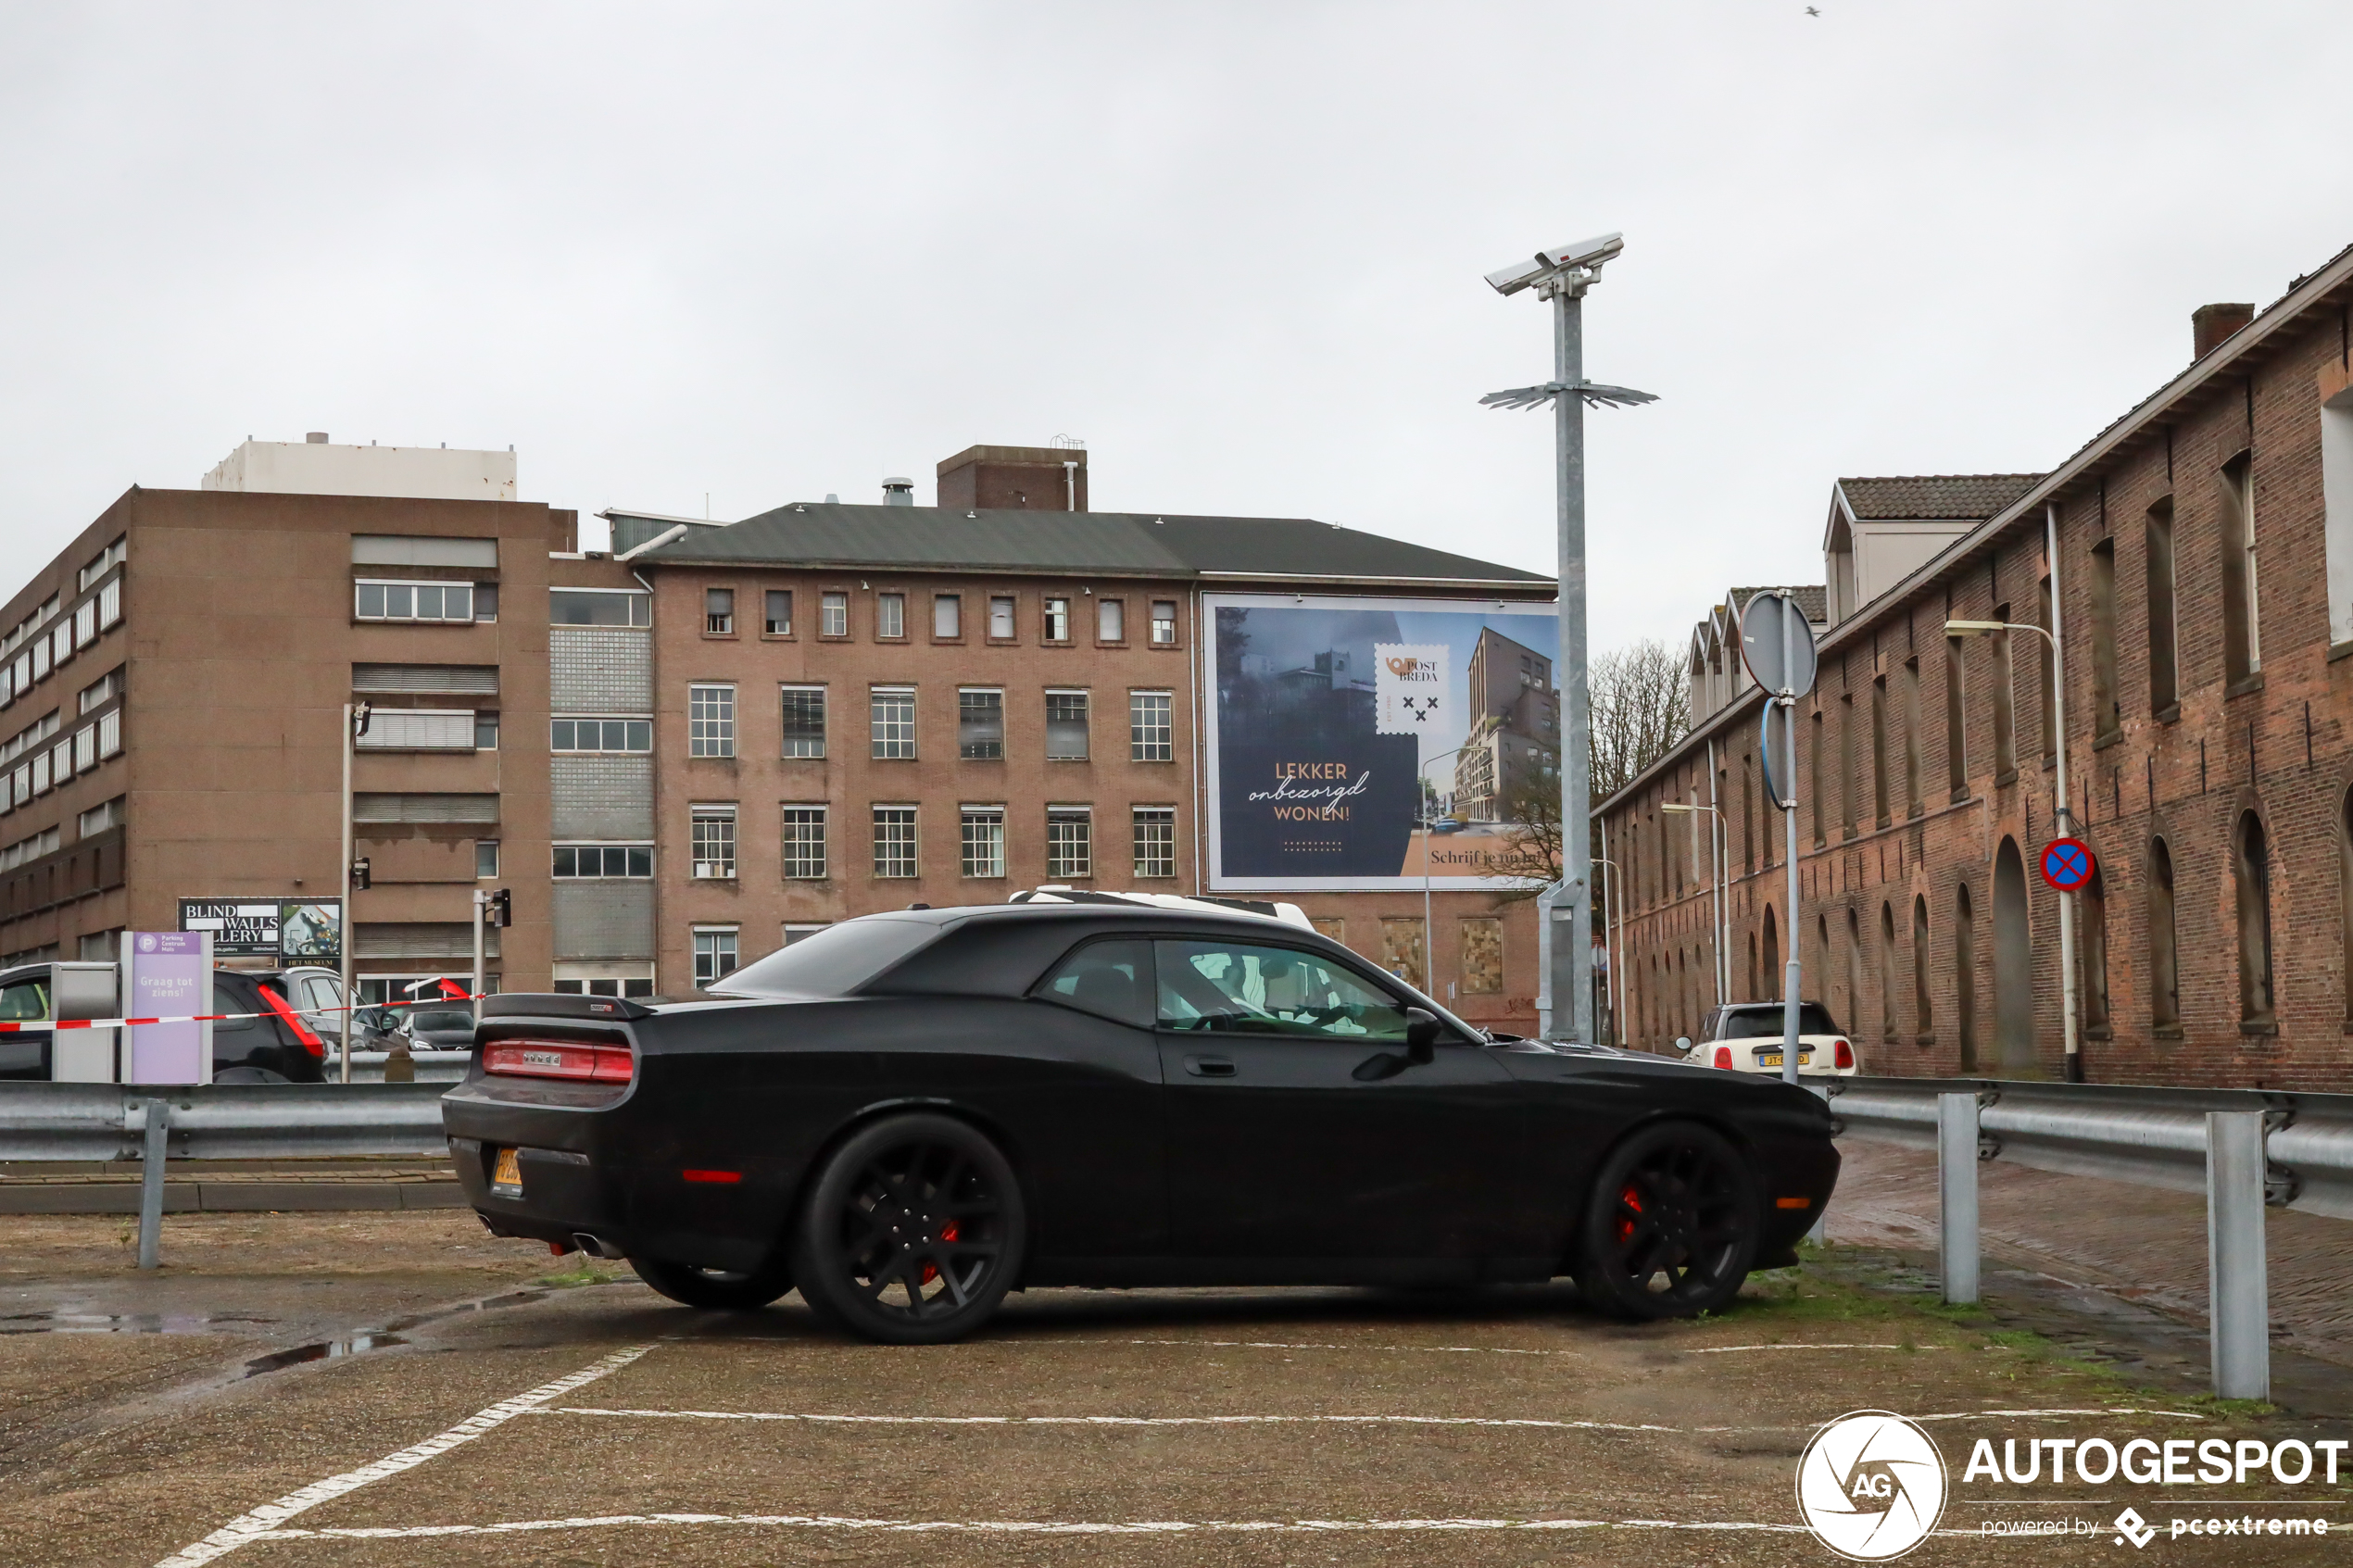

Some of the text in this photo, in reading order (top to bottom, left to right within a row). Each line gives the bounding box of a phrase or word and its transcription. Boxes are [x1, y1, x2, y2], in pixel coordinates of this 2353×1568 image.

[1407, 661, 1437, 671] POST
[1400, 672, 1438, 682] BREDA
[1276, 762, 1347, 779] LEKKER
[1249, 771, 1369, 814] onbezorgd
[1274, 807, 1350, 821] WONEN!
[1431, 850, 1479, 866] Schrijf
[1484, 850, 1496, 866] je
[186, 906, 237, 918] BLIND
[224, 917, 278, 930] WALLS
[144, 938, 153, 949] P
[140, 977, 193, 987] Graag tot
[152, 987, 183, 997] ziens!
